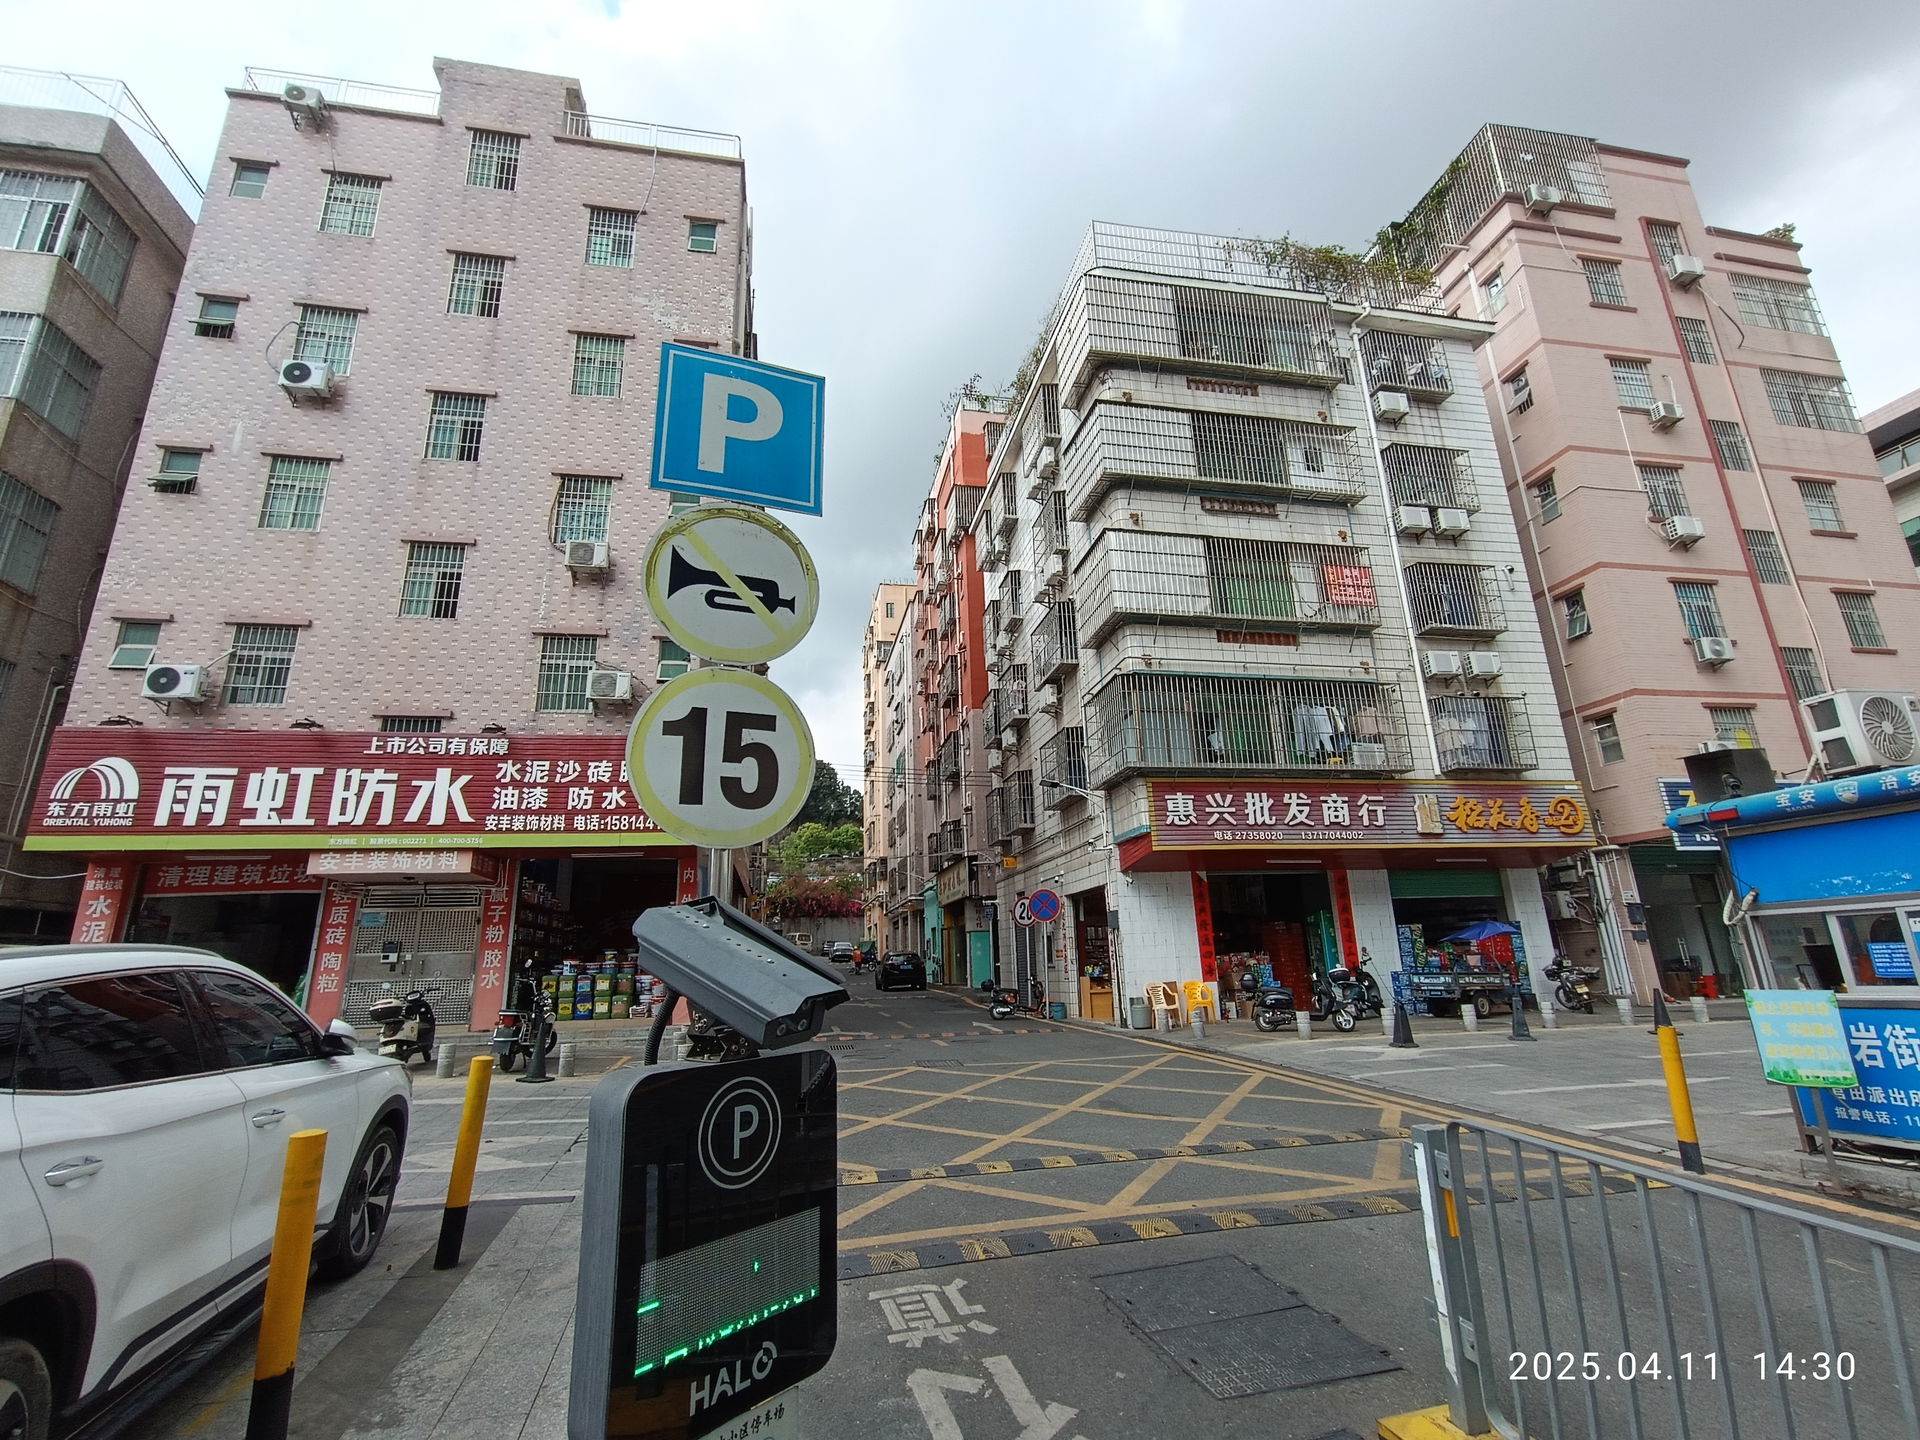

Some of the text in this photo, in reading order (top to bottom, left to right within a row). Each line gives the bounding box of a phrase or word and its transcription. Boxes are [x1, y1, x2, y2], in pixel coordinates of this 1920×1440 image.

[697, 372, 783, 473] P
[364, 737, 509, 756] 上市公司有保障
[662, 706, 779, 810] 15
[46, 801, 138, 817] 东方雨虹
[154, 766, 476, 827] 雨虹防水
[491, 786, 549, 811] 油漆
[1776, 789, 1815, 807] 宝安
[43, 818, 133, 826] ORIENTAL YUHONG
[1165, 792, 1387, 827] 惠兴批发商行
[485, 814, 566, 831] 安丰装饰材料
[1213, 830, 1364, 841] 电话 27358020 13717044002
[319, 851, 459, 871] 安丰装饰材料
[157, 863, 317, 888] 清理建筑垃圾
[80, 895, 113, 943] 水泥
[732, 1104, 759, 1160] P
[689, 1341, 778, 1417] HALO
